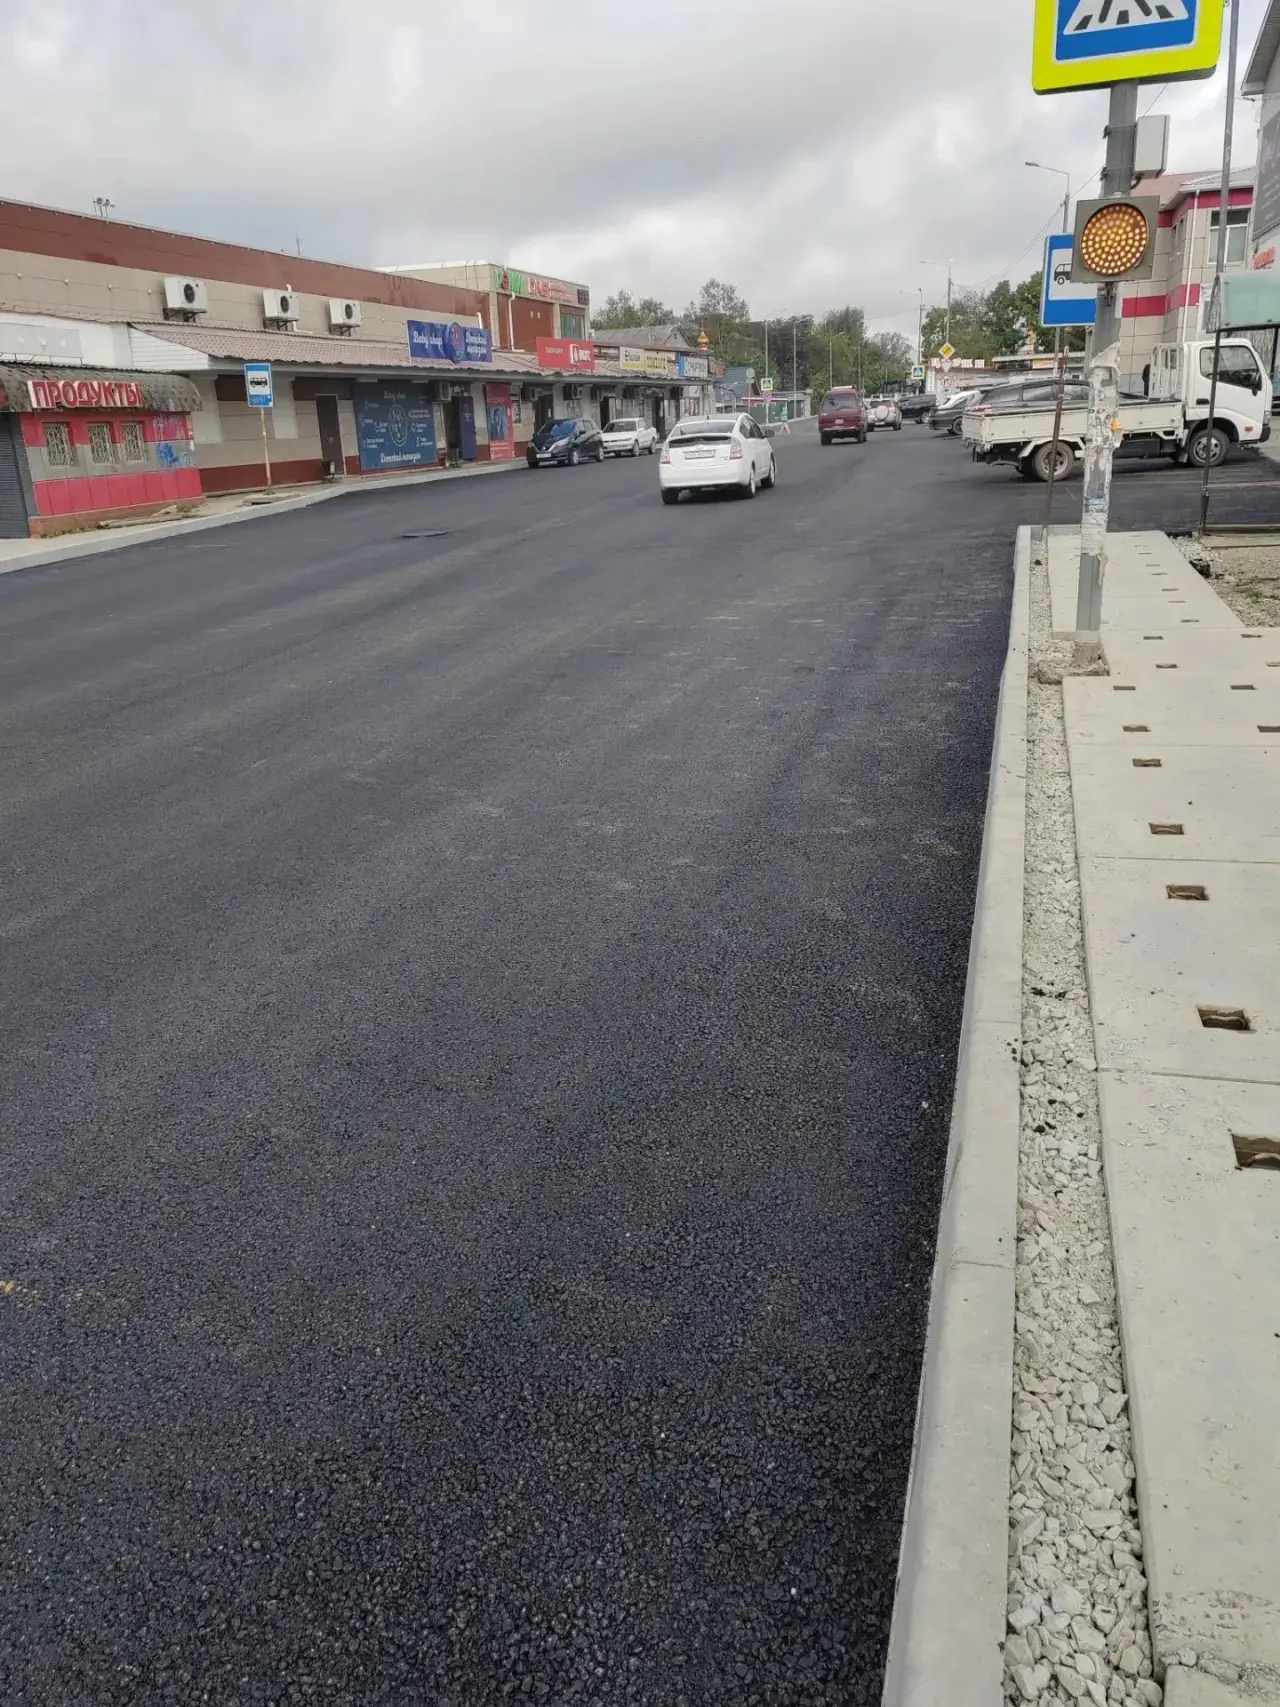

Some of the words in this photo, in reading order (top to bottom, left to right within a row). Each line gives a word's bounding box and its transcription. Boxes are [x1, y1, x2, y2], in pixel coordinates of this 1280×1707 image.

[413, 330, 429, 348] Baby
[429, 332, 443, 349] shop
[30, 380, 143, 407] ПРОДУКТЫ
